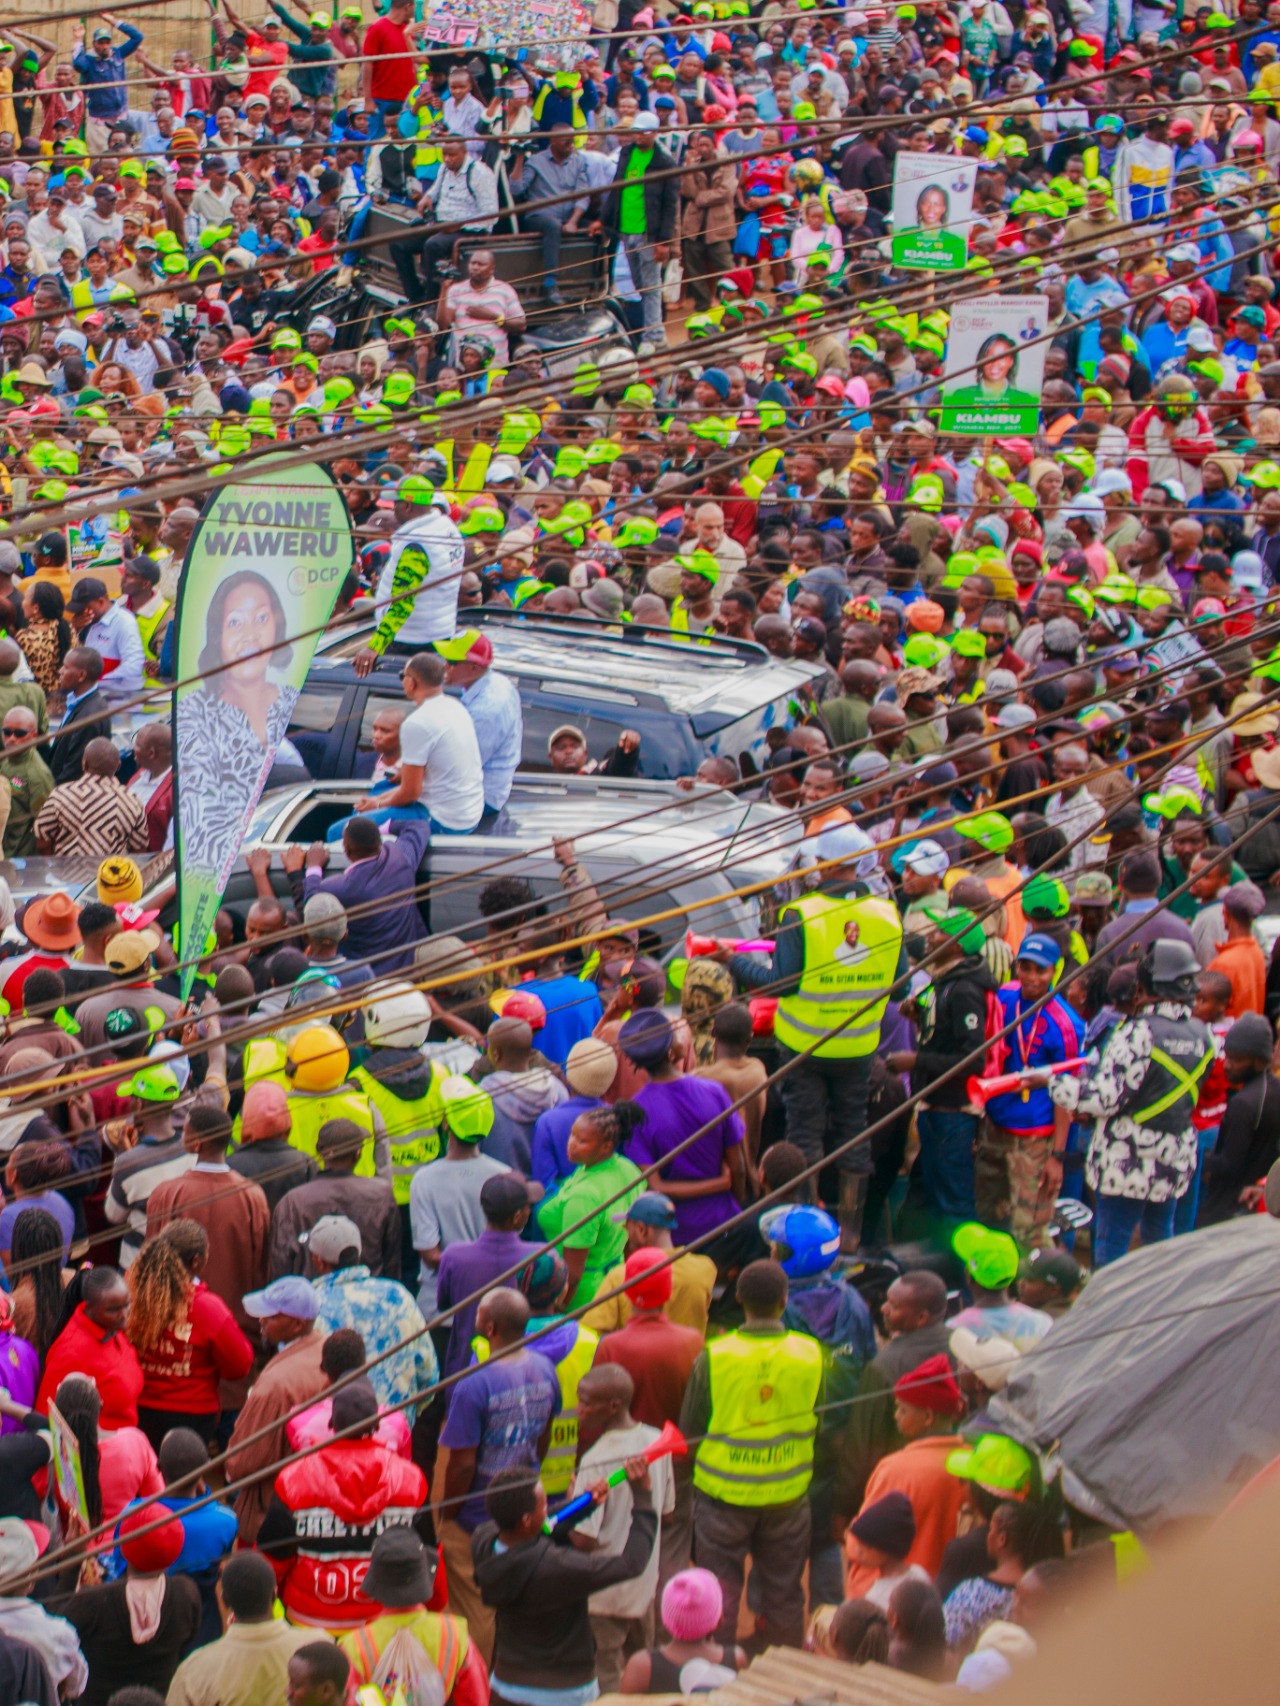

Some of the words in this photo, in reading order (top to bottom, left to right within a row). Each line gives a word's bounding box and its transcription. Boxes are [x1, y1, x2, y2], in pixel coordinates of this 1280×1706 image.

[956, 413, 1021, 424] KIAMBU
[217, 501, 331, 529] YVONNE
[205, 531, 338, 558] WAWERU
[308, 567, 339, 584] DCP
